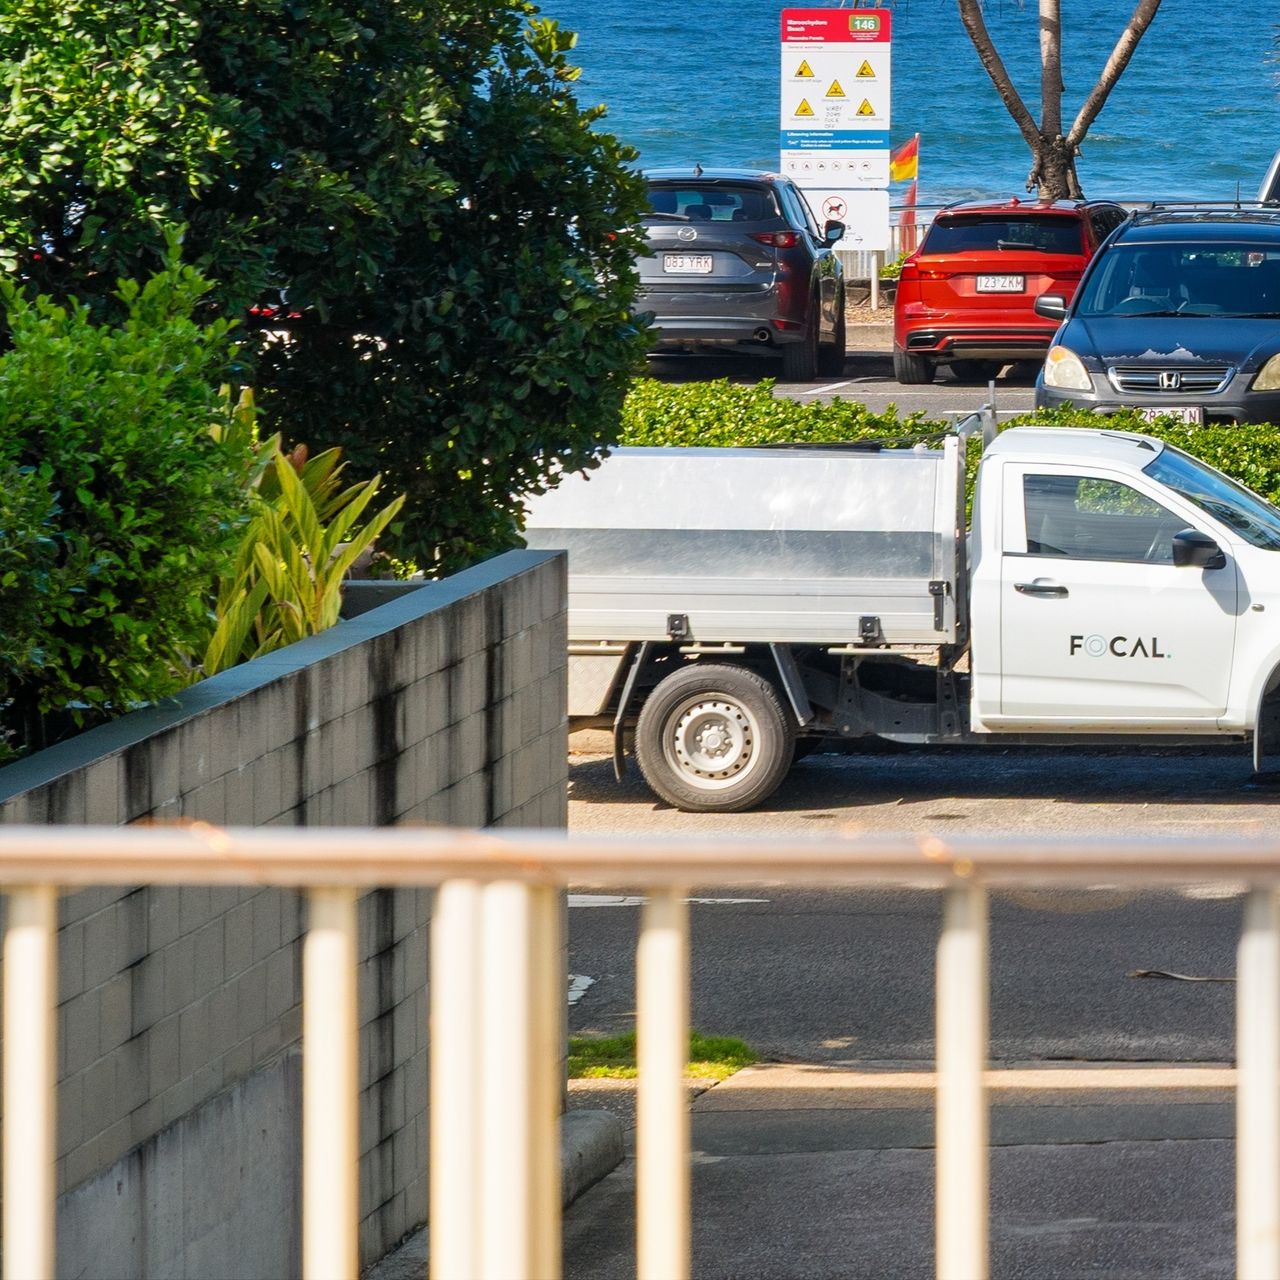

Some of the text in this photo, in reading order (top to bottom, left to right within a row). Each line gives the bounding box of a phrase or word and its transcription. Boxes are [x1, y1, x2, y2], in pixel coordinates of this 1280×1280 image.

[854, 19, 875, 30] 146
[688, 256, 710, 268] YRK
[979, 276, 996, 288] 123
